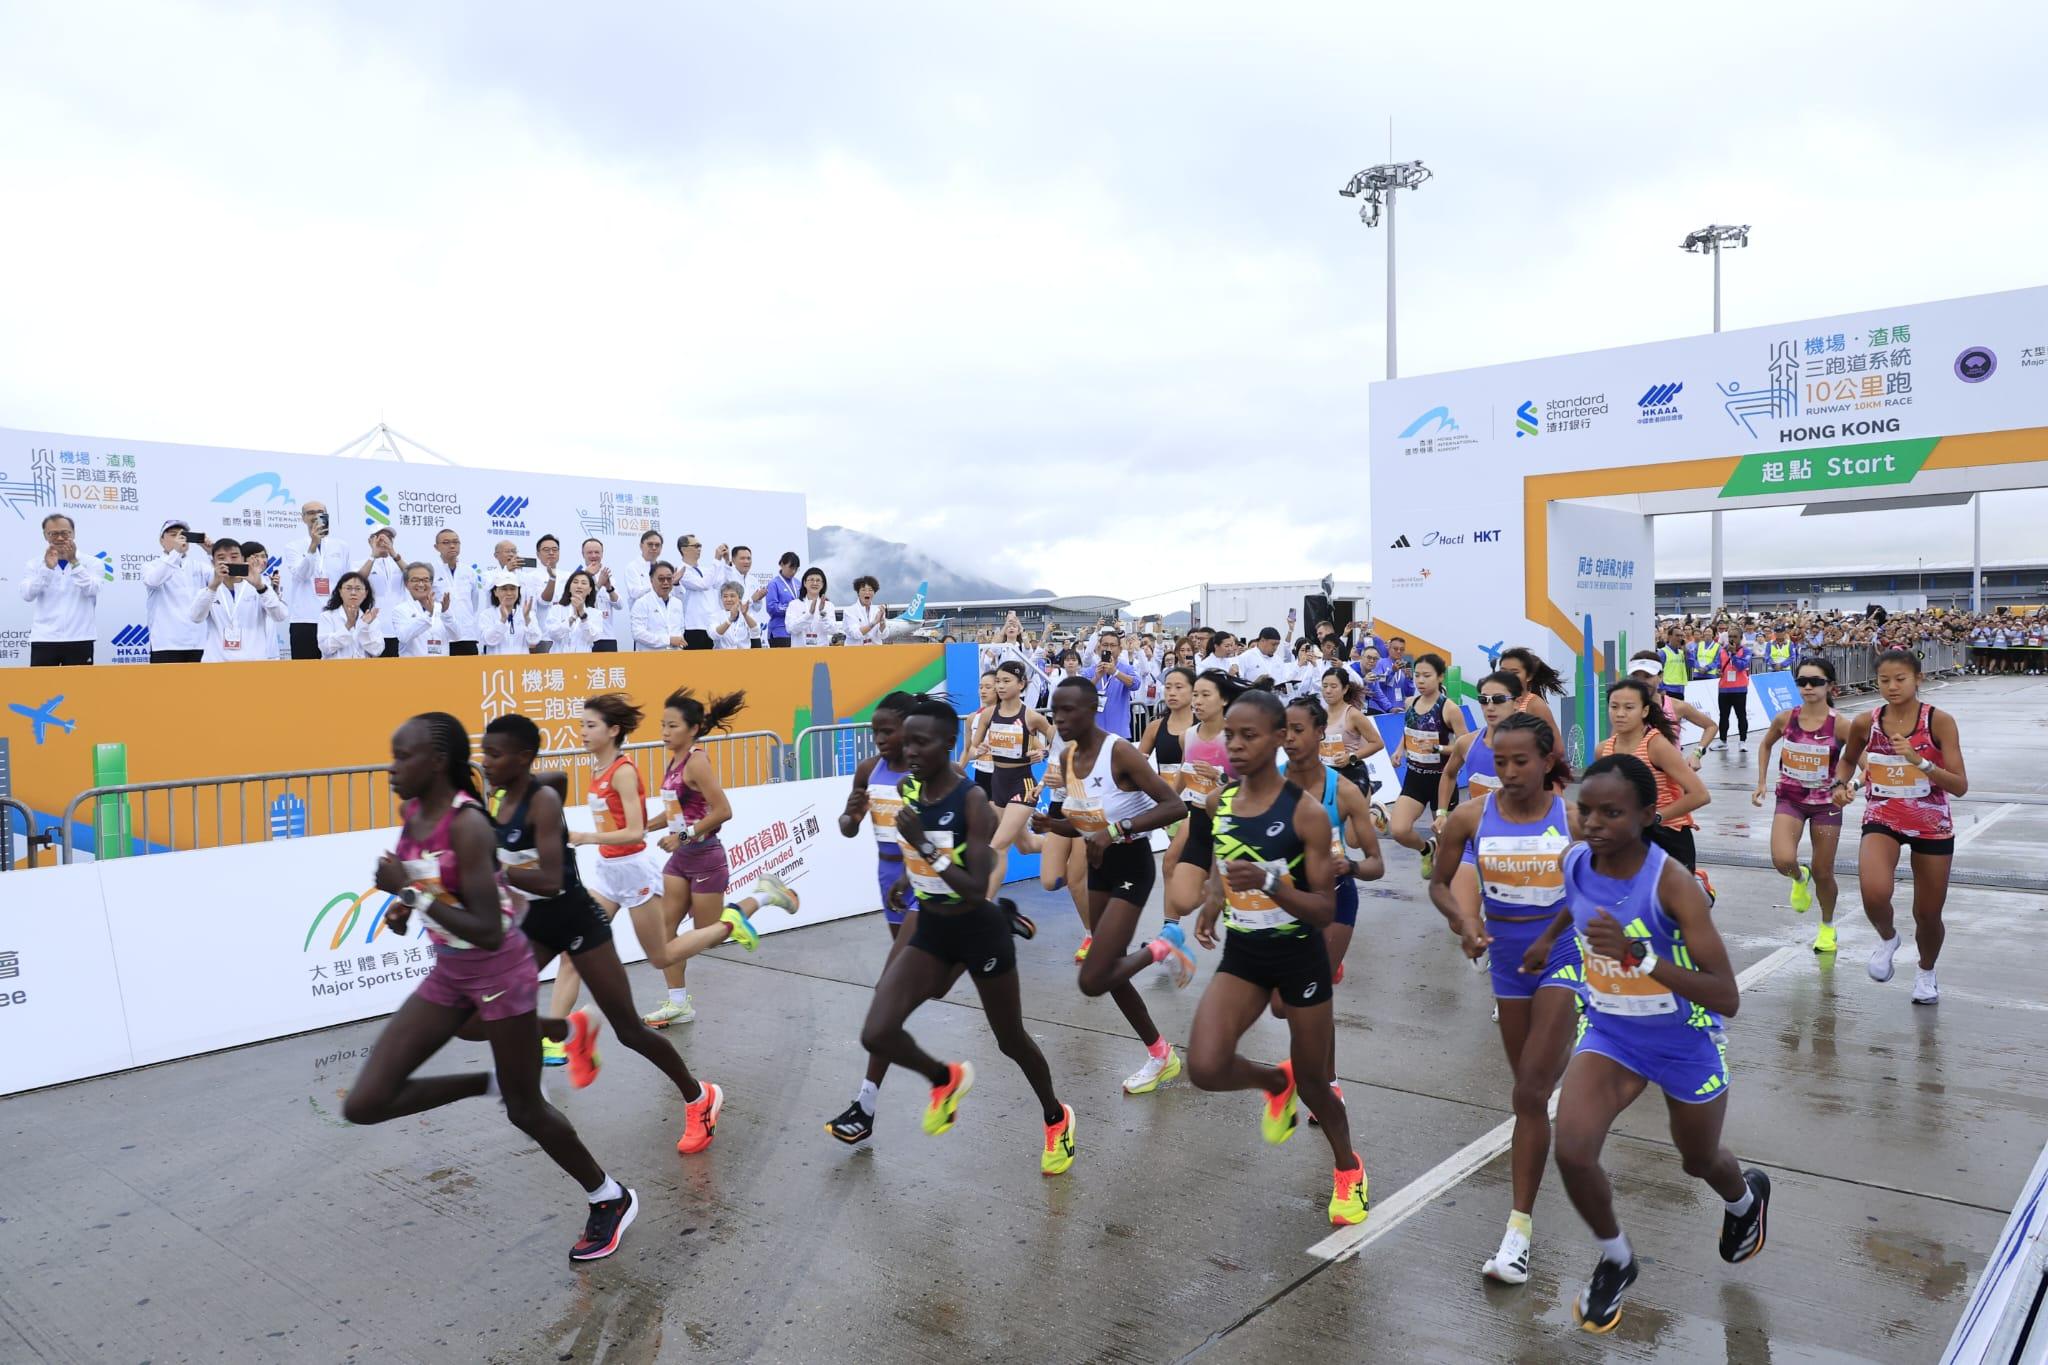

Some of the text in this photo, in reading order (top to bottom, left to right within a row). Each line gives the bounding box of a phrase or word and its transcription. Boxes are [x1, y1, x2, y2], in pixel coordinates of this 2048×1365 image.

[1805, 347, 1912, 378] 三跑道系統
[1805, 371, 1912, 404] 10公里跑
[1546, 393, 1605, 410] standard
[1806, 396, 1913, 415] RUNWAY 10KM RACE
[1546, 404, 1609, 421] chartered
[1642, 406, 1678, 417] HKAAA
[1546, 418, 1592, 433] 渣打銀行
[1780, 418, 1900, 443] HONG KONG
[60, 467, 138, 485] 三跑道系統
[1761, 454, 1896, 483] 起點 Start
[62, 483, 139, 503] 10公里跑
[398, 490, 457, 503] standard
[63, 502, 96, 510] RUNWAY
[120, 504, 140, 512] RACE
[398, 502, 462, 515] chartered
[399, 514, 445, 527] 渣打銀行
[492, 520, 526, 528] HKAAA
[1473, 529, 1502, 543] HKT
[991, 732, 1016, 744] Wong
[1787, 751, 1821, 766] Tsang
[1887, 767, 1905, 777] 24
[792, 815, 821, 846] 計劃
[1484, 856, 1558, 876] Mekuriya
[1523, 876, 1531, 886] 7
[311, 978, 354, 997] Major
[358, 971, 403, 989] Sports
